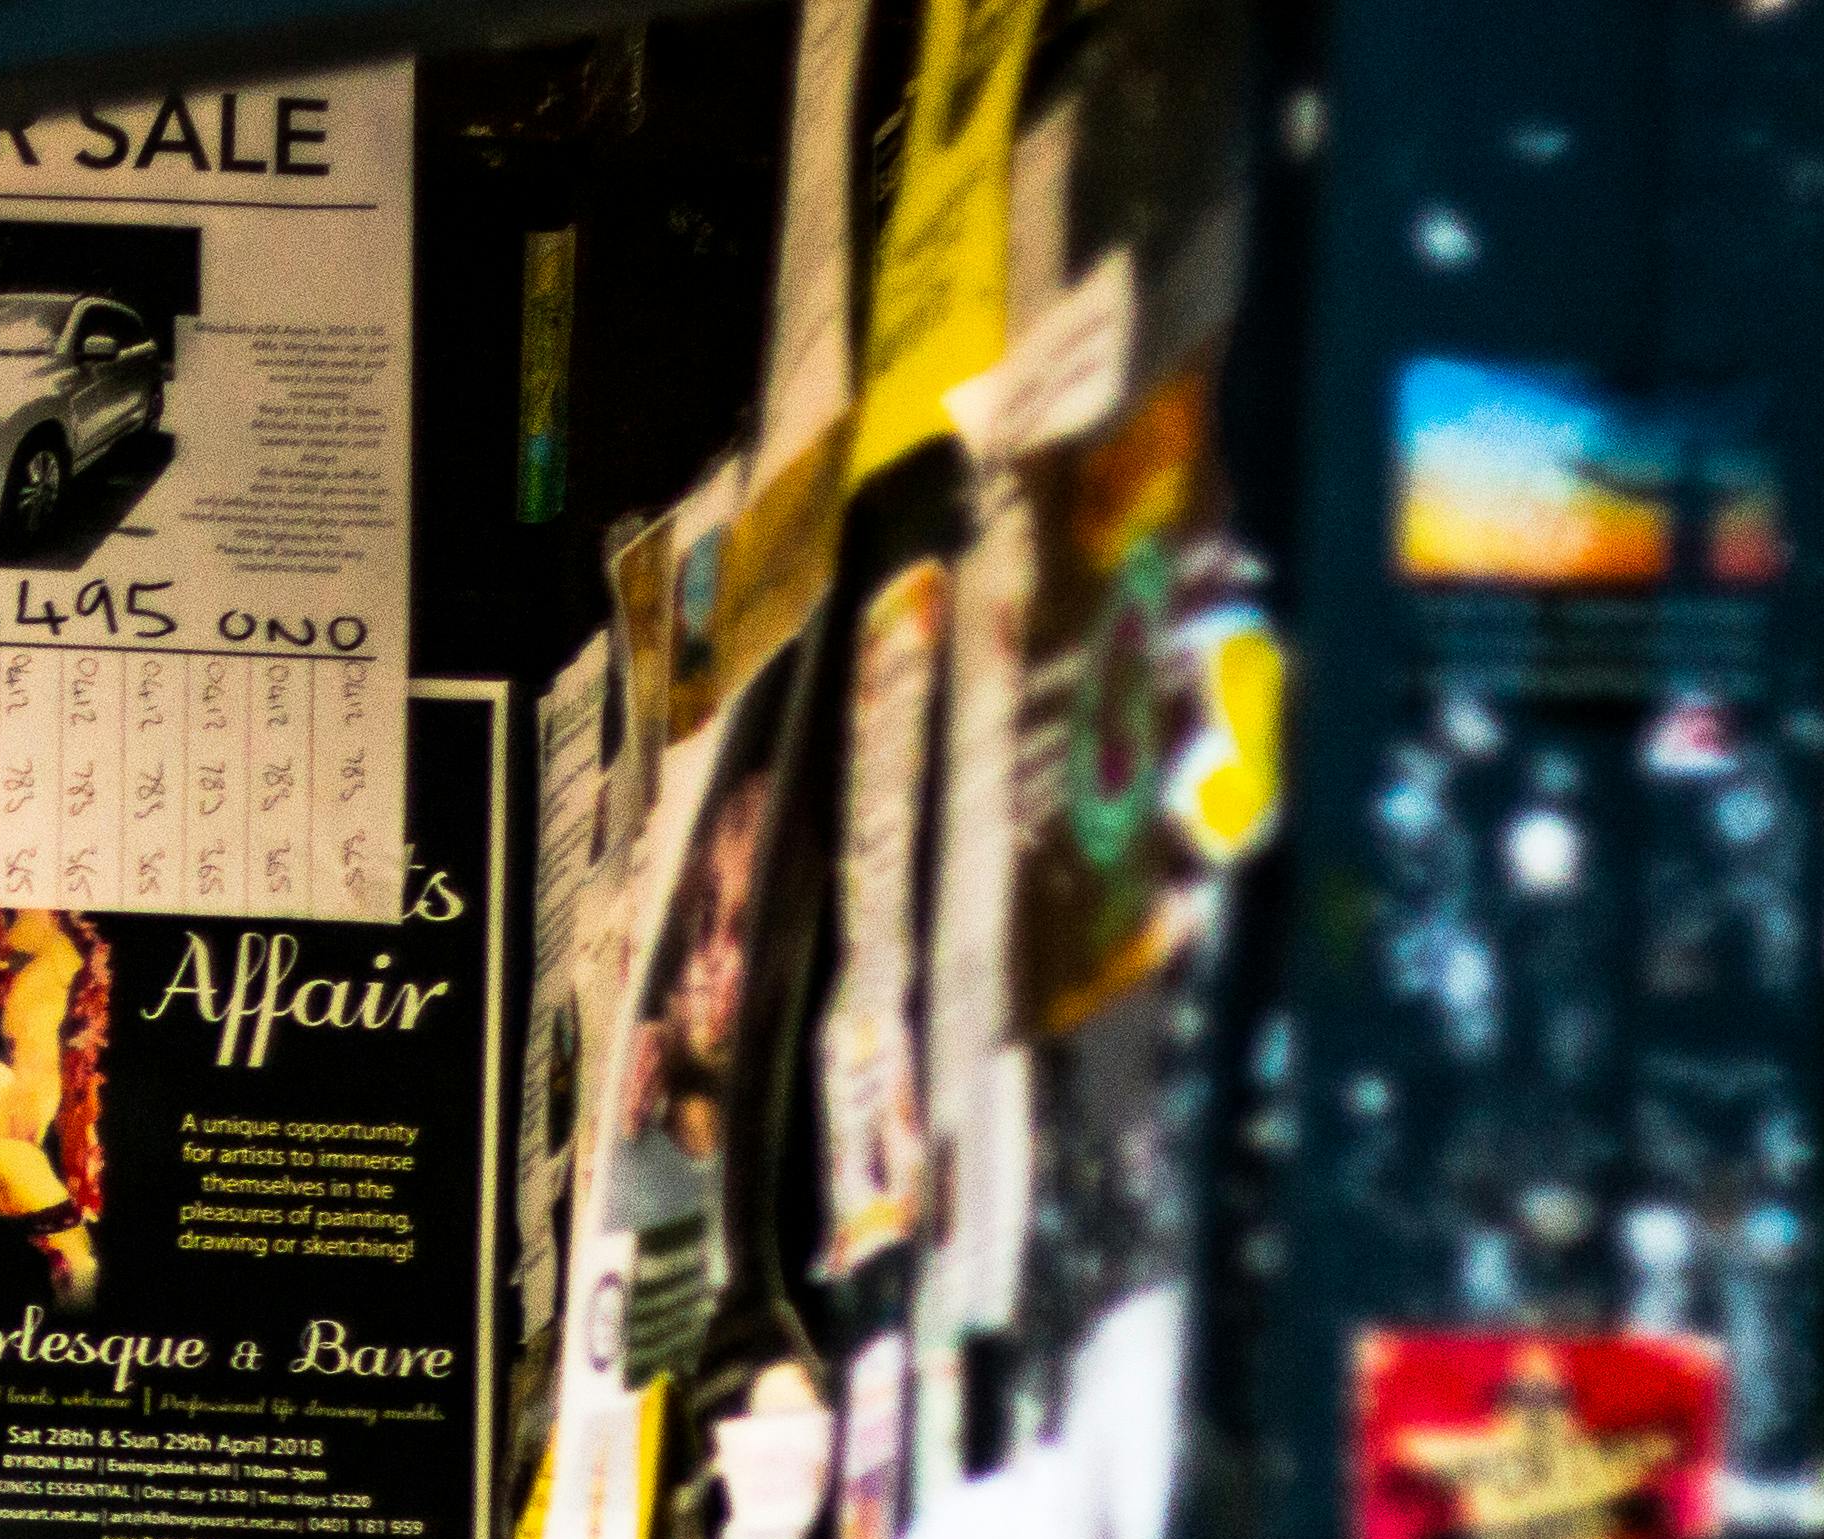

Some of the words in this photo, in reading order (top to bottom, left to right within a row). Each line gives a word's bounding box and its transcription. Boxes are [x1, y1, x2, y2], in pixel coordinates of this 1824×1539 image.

[74, 94, 330, 177] SALE
[141, 929, 447, 1069] Affair
[290, 1318, 454, 1379] Bare
